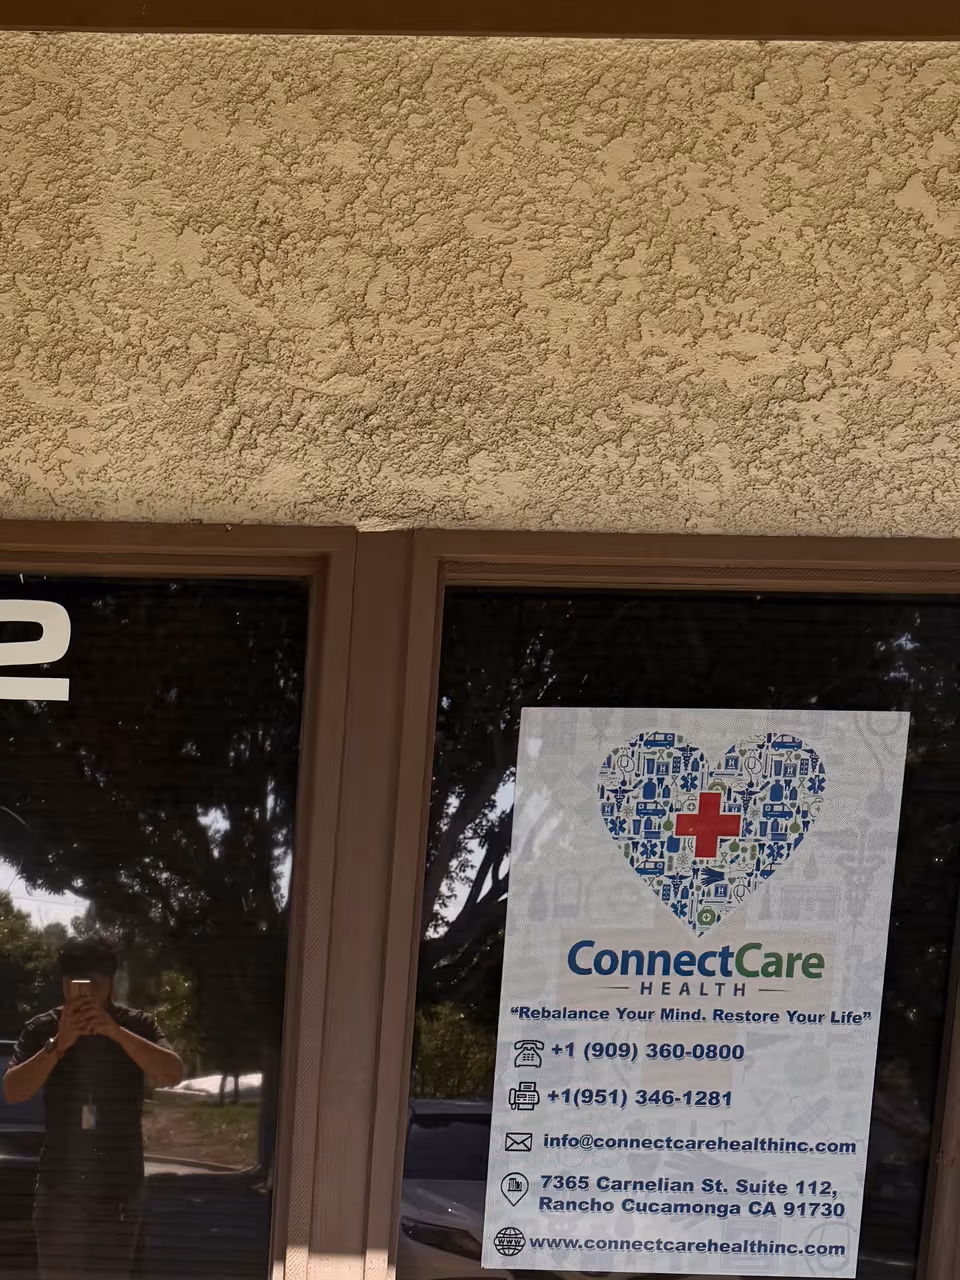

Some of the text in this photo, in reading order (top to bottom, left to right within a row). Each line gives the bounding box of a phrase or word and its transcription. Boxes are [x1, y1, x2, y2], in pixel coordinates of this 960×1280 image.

[567, 939, 826, 979] ConnectCare
[640, 981, 746, 997] HEALTH
[510, 1006, 872, 1024] “Rebalance Your Mind. Restore Your Life”
[551, 1042, 745, 1063] +1 (909) 360-0800
[547, 1088, 732, 1109] +1(951) 346-1281
[543, 1133, 856, 1153] info@connectcarehealthinc.com
[540, 1175, 838, 1199] 7365 Carnelian St. Suite 112,
[539, 1196, 845, 1218] Rancho Cucamonga CA 91730
[529, 1236, 846, 1256] www.connectcarehealthinc.com
